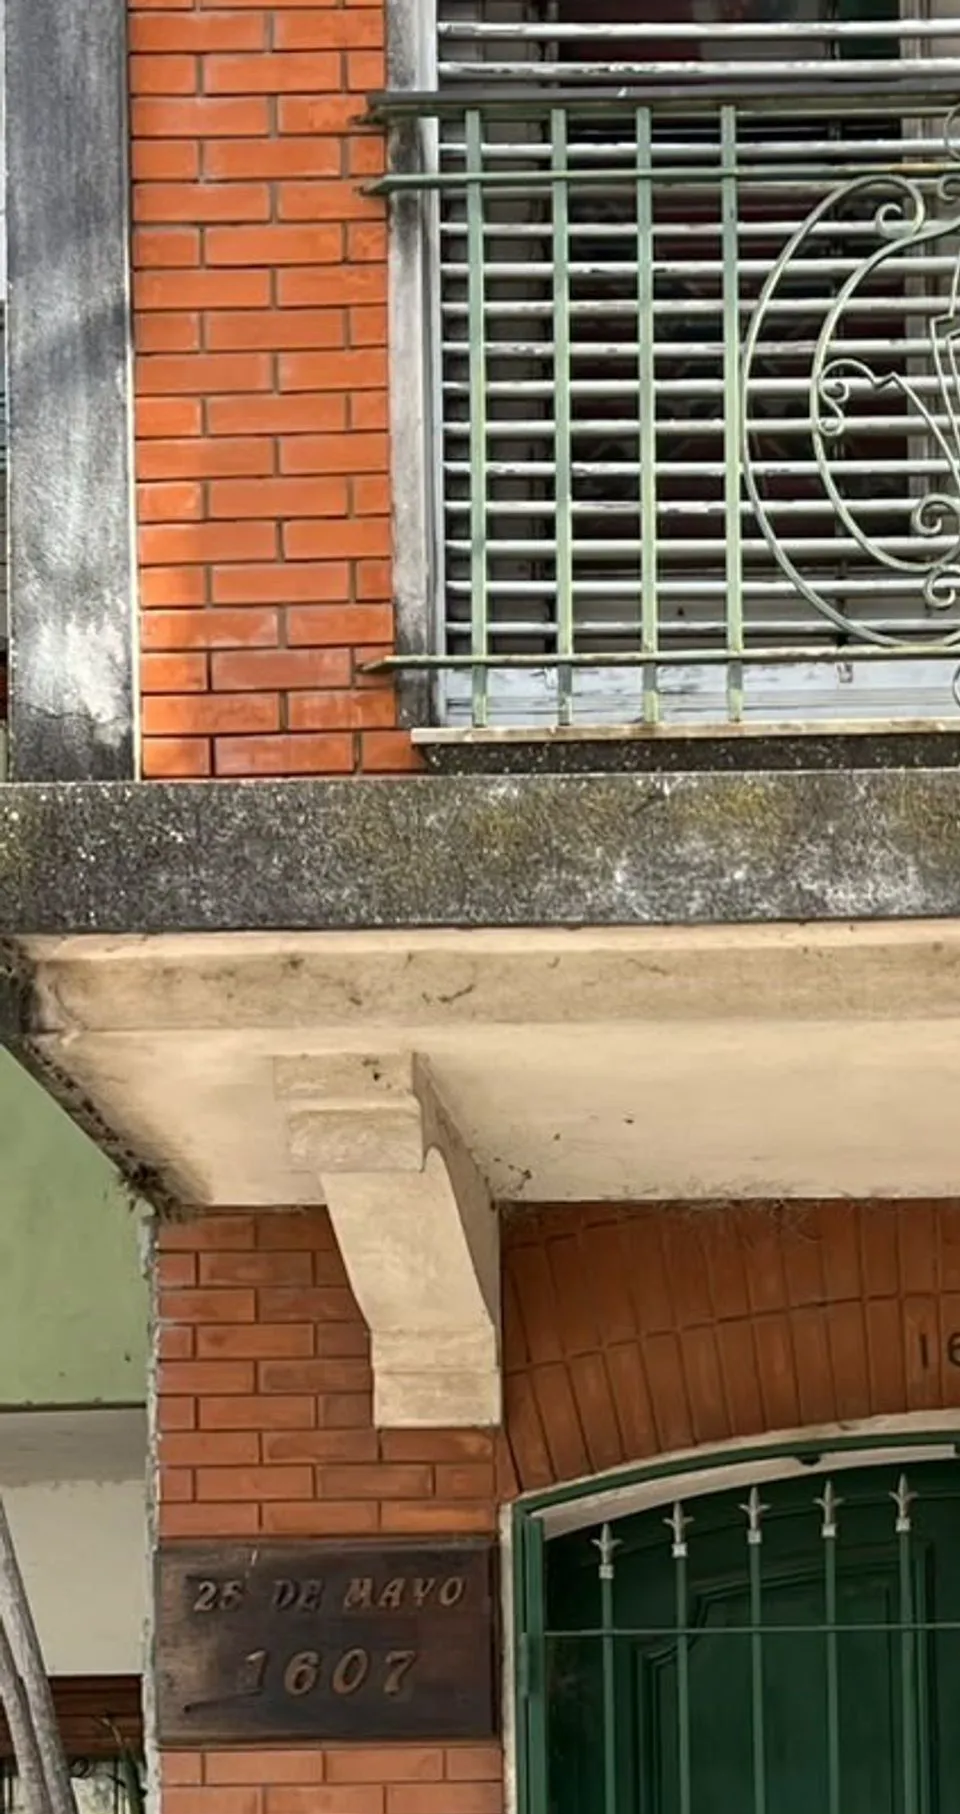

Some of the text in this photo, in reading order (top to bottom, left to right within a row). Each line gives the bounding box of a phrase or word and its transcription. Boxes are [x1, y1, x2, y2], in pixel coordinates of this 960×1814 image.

[272, 1578, 325, 1612] DE
[343, 1576, 468, 1609] MAYO
[239, 1648, 416, 1696] 1607
